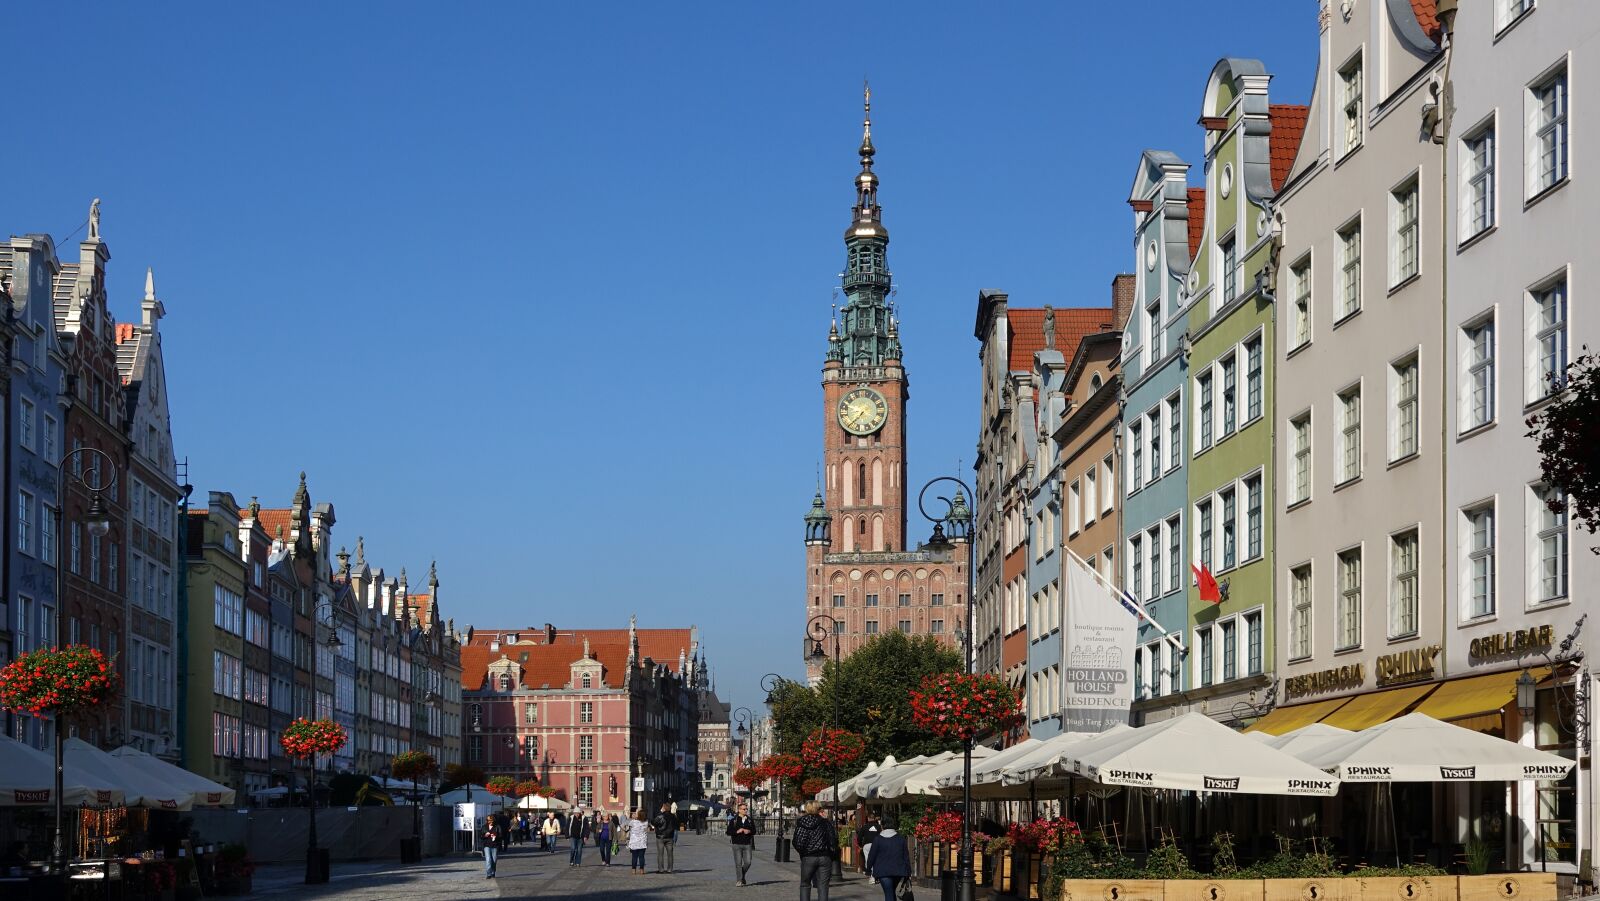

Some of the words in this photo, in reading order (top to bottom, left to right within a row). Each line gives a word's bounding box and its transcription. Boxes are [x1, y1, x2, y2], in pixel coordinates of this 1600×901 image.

[1074, 624, 1103, 632] boutique
[1375, 646, 1435, 681] SPHINX
[1068, 670, 1125, 682] HOLLAND
[1076, 682, 1113, 692] HOUSE
[1066, 697, 1127, 707] RESIDENCE
[1109, 769, 1153, 781] SPHINX
[1347, 766, 1392, 775] SPHINX
[1442, 769, 1474, 778] TYSKIE
[1523, 766, 1567, 774] SPHINX
[1108, 778, 1153, 786] RESTAURACJE
[1205, 778, 1238, 789] TYSKIE
[1287, 779, 1332, 789] SPHINX
[16, 791, 48, 801] TYSKIE
